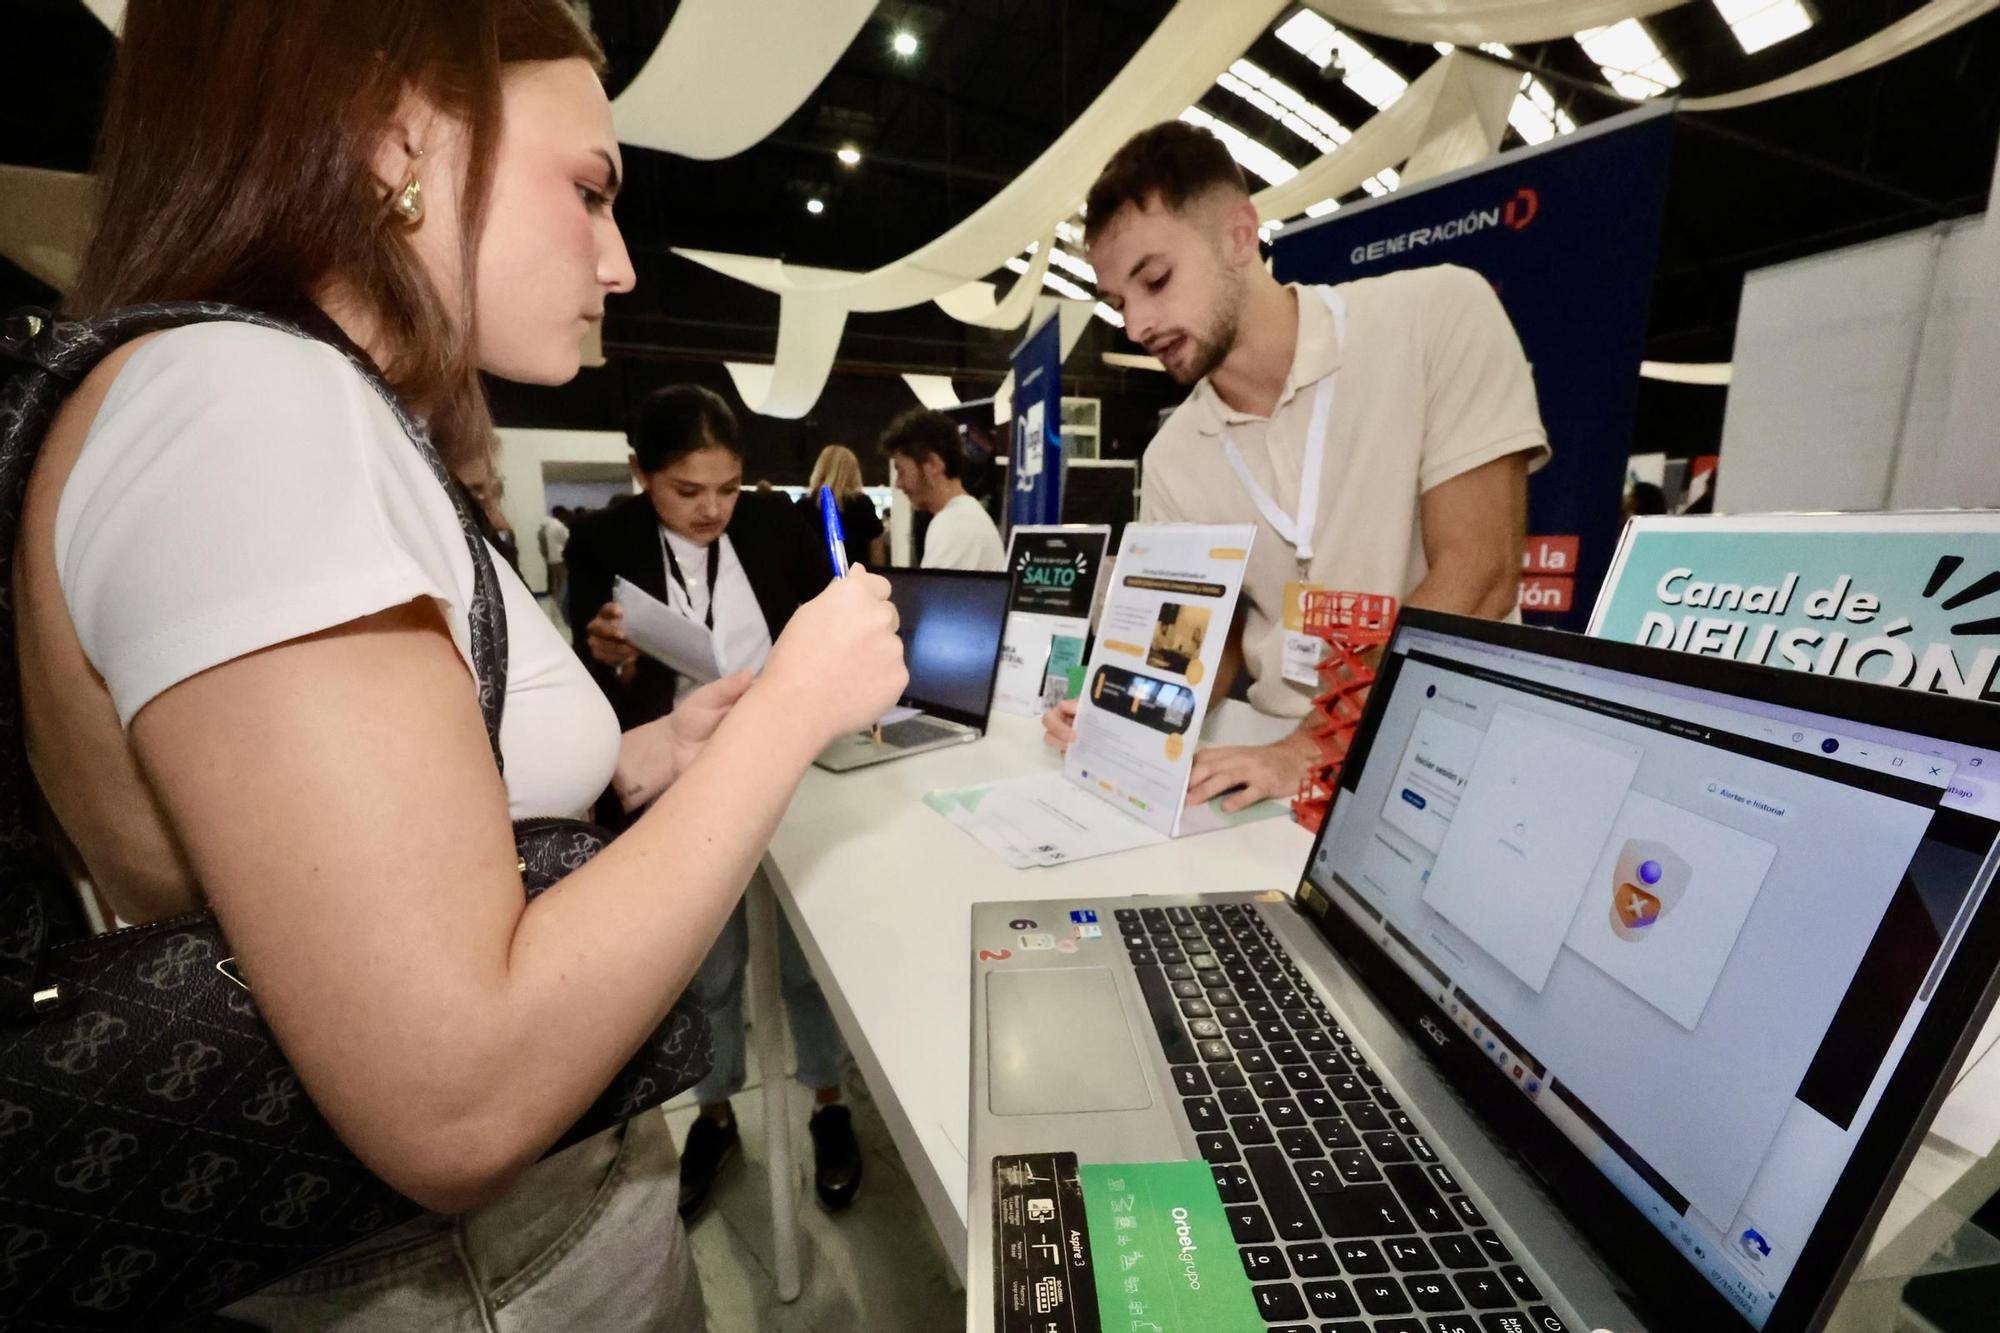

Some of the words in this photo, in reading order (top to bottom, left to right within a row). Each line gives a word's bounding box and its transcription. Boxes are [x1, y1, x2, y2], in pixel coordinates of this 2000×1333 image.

[1350, 207, 1499, 265] GENERACIÓN
[1539, 543, 1567, 569] la
[1023, 566, 1076, 586] SALTO
[1656, 567, 1799, 616] Canal
[1803, 574, 1880, 624] de
[1753, 800, 1786, 816] historial
[1420, 1015, 1450, 1046] acer
[1070, 1230, 1082, 1259] Aspire
[1404, 1247, 1417, 1255] 7
[1258, 1256, 1270, 1264] 0
[1324, 1291, 1337, 1299] 2
[1375, 1288, 1389, 1296] 5
[1426, 1285, 1440, 1294] 8
